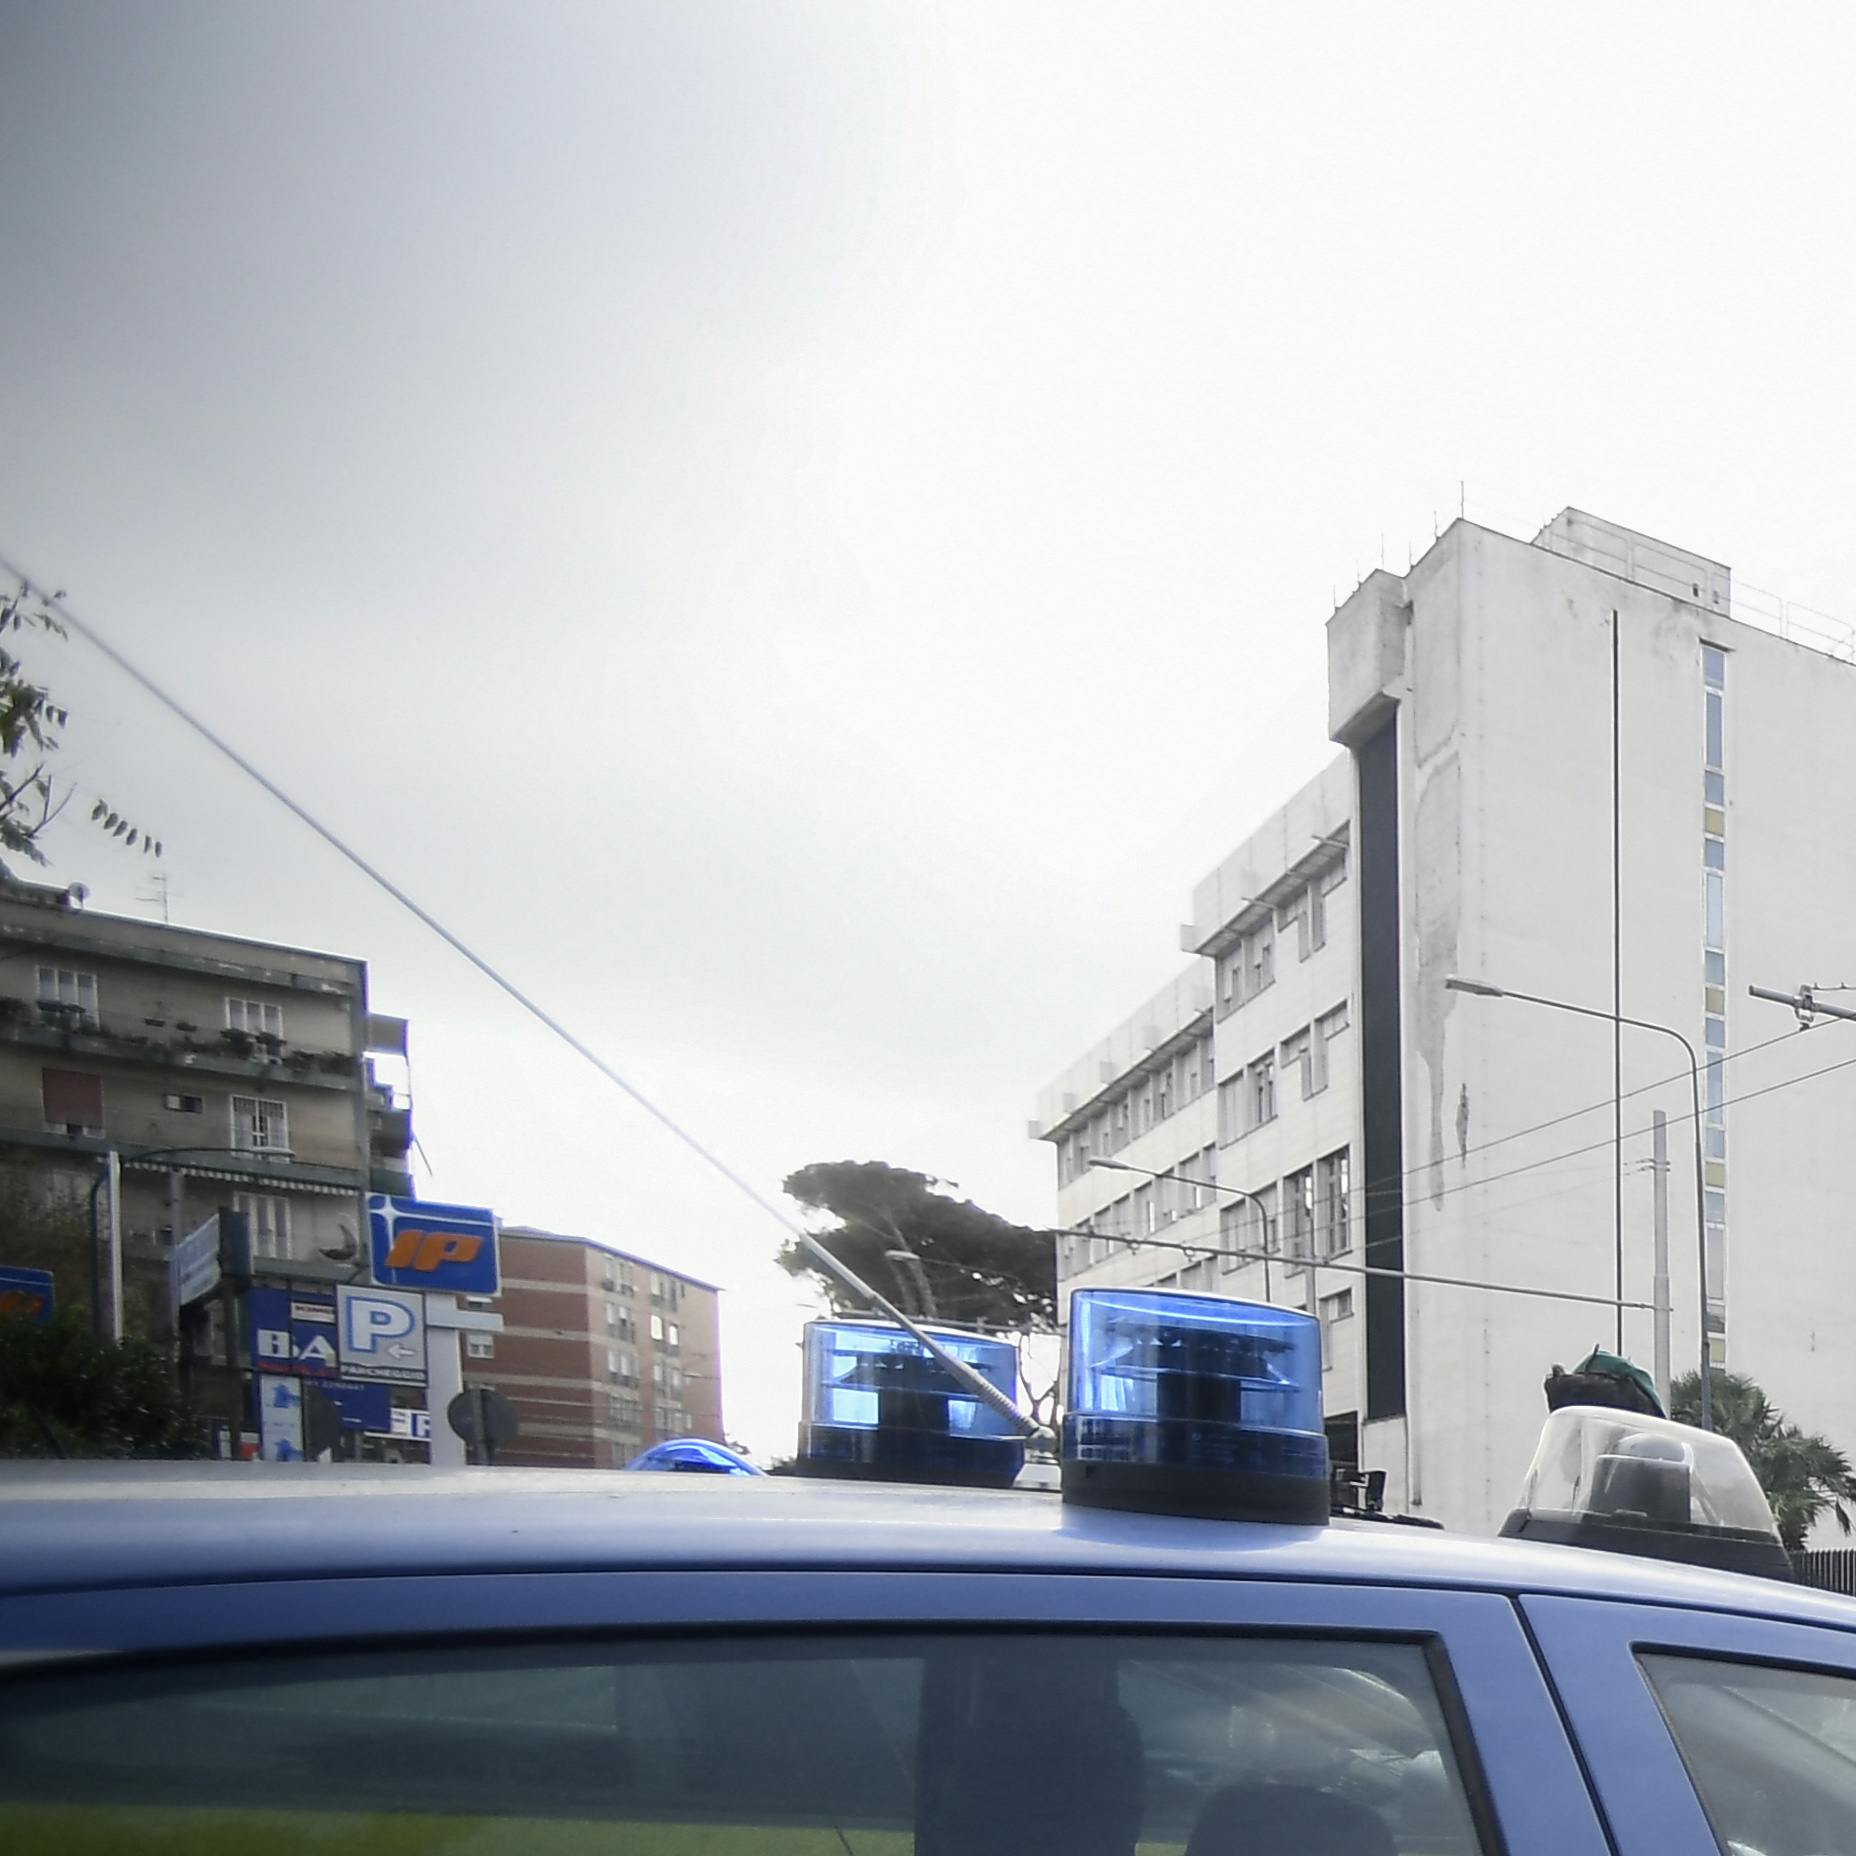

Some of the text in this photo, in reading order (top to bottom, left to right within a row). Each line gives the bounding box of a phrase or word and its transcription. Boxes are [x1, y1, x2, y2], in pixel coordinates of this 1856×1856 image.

[386, 1229, 483, 1271] IP
[347, 1296, 415, 1353] P
[258, 1329, 337, 1367] BA
